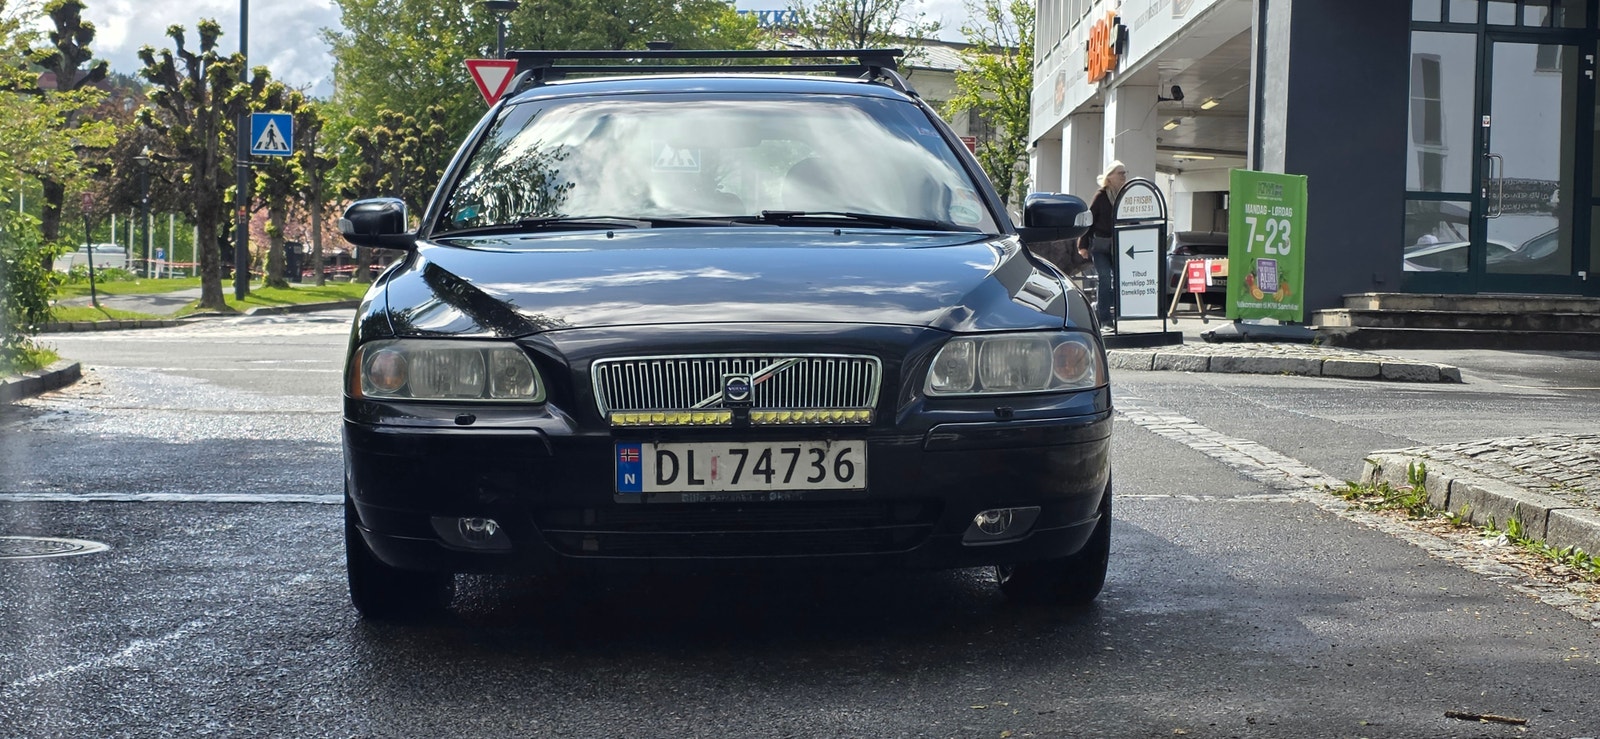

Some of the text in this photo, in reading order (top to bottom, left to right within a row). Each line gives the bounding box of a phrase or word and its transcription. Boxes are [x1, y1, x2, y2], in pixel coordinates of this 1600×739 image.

[1134, 195, 1152, 205] FRISØR
[1245, 204, 1267, 215] MANDAG
[1272, 206, 1293, 217] LØRDAG
[1245, 216, 1291, 256] 7-23
[655, 447, 855, 486] DL 74736
[624, 473, 635, 485] N
